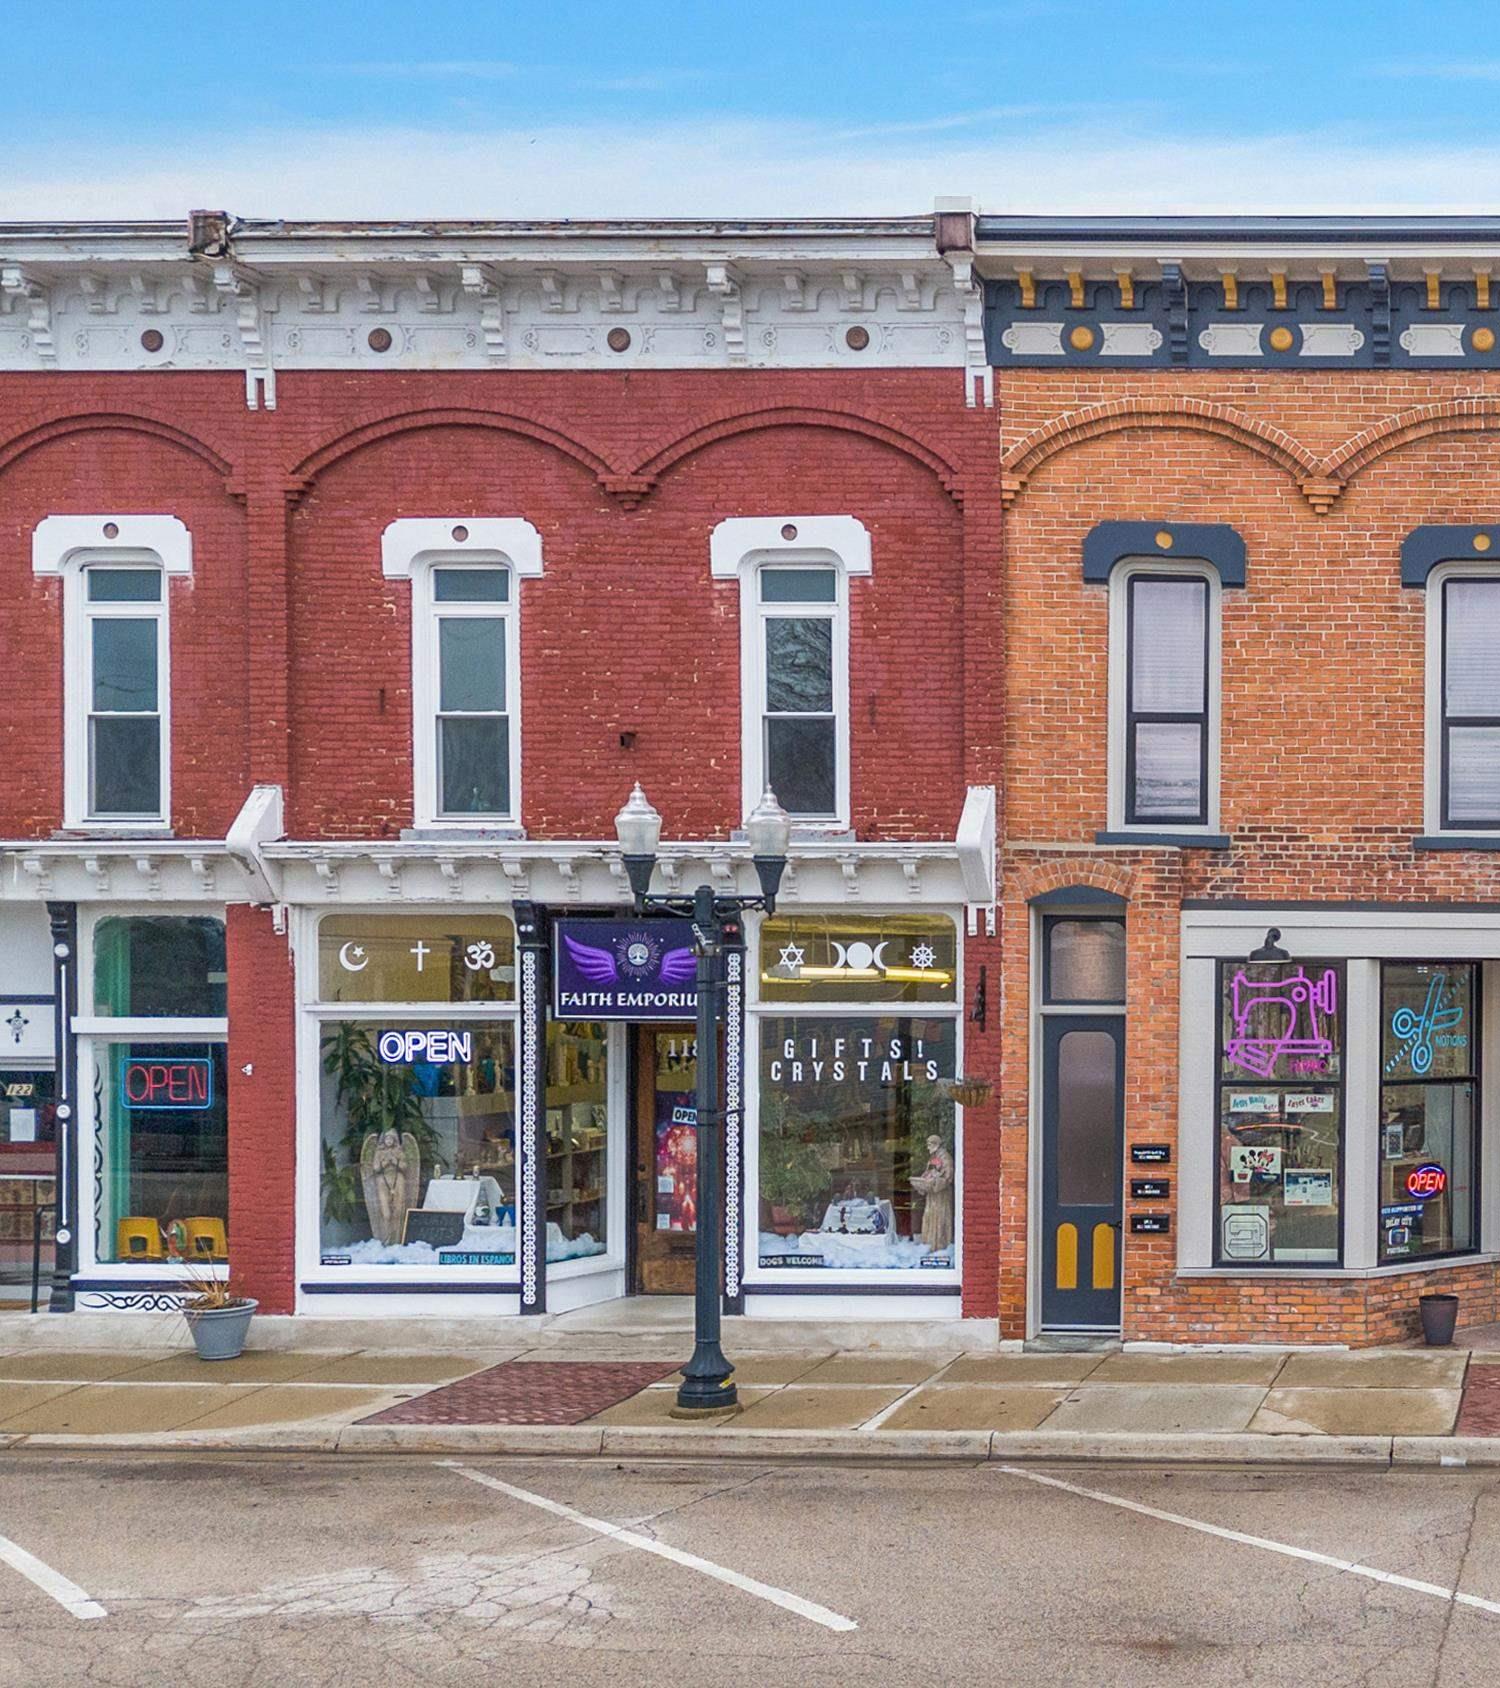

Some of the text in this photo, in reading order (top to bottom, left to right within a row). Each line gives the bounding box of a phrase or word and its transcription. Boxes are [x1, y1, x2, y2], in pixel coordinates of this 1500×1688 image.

[561, 992, 698, 1006] FAITH EMPORIU
[379, 1032, 471, 1062] OPEN
[784, 1038, 924, 1059] GIFTS!
[1435, 1035, 1468, 1047] NOTIONS
[770, 1060, 938, 1082] CRYSTALS
[10, 1085, 31, 1094] 122
[126, 1065, 208, 1101] OPEN
[1408, 1173, 1445, 1191] OPEN
[440, 1253, 467, 1264] LIBROS
[469, 1253, 480, 1264] EN
[760, 1256, 823, 1266] DOGS WELCOME
